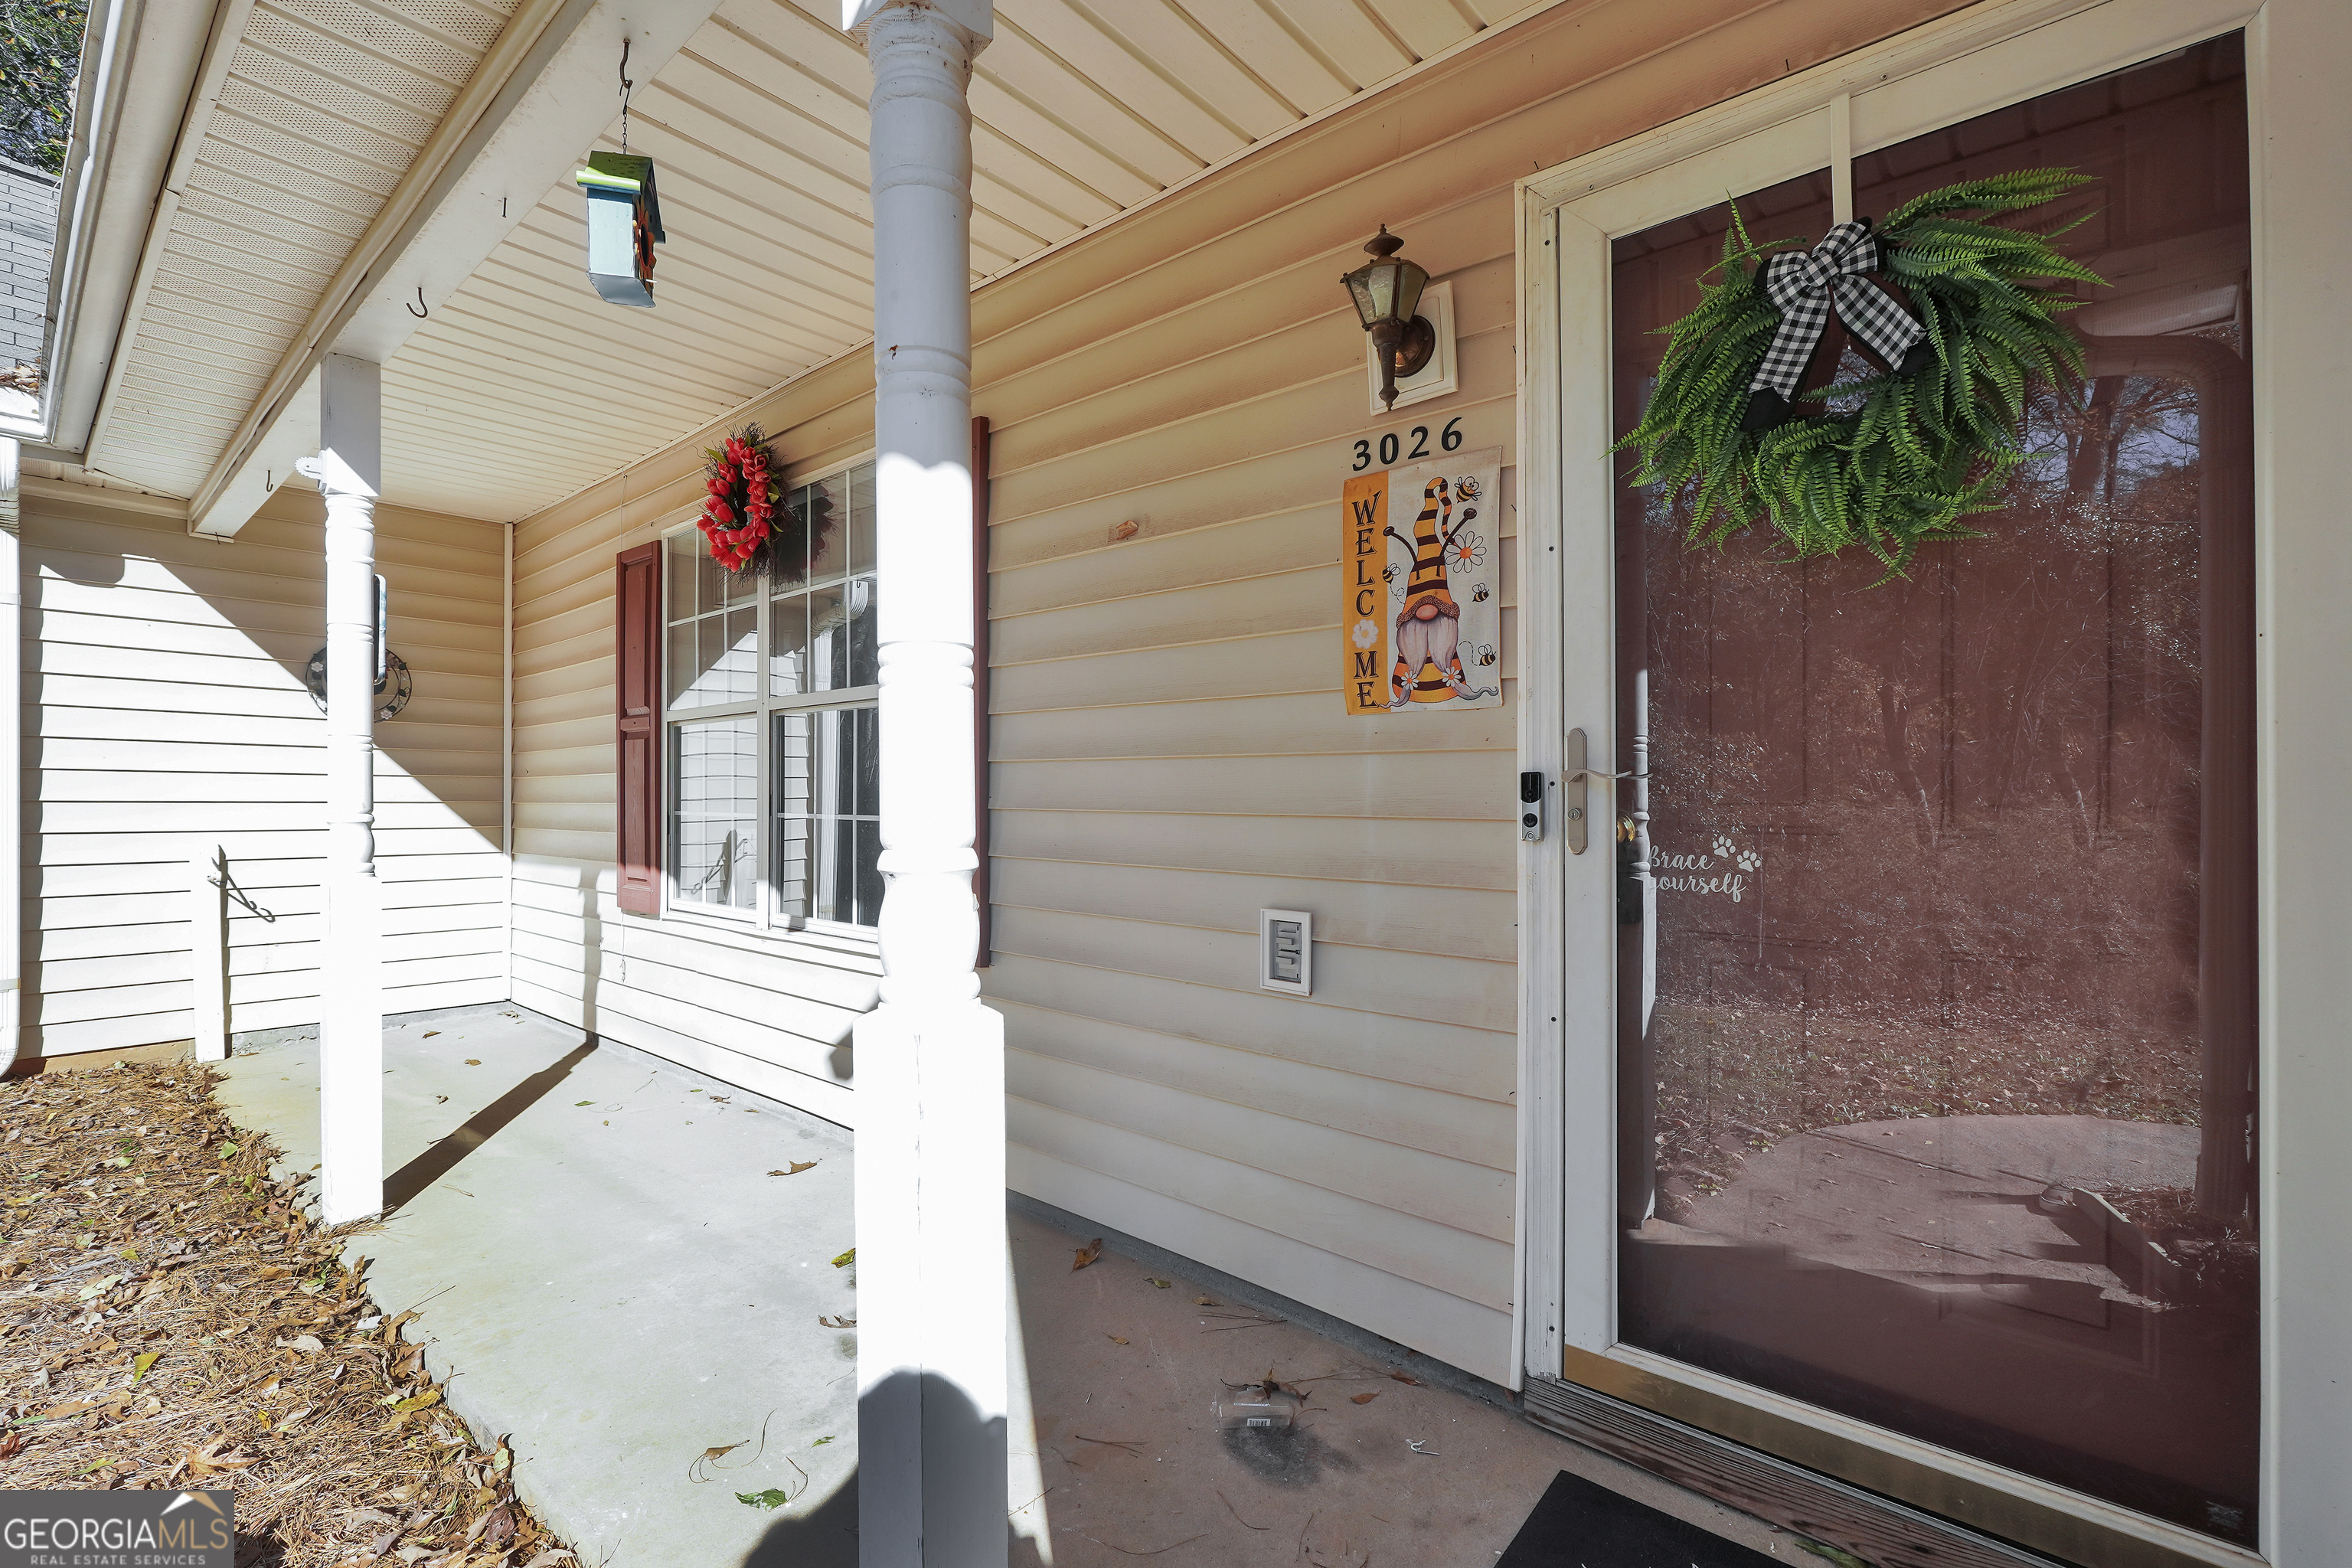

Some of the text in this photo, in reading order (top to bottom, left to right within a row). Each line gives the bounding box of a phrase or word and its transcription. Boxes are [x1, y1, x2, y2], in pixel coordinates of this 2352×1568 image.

[1352, 416, 1463, 472] 3026
[1649, 844, 1714, 871] Brace
[1654, 872, 1747, 903] ourself
